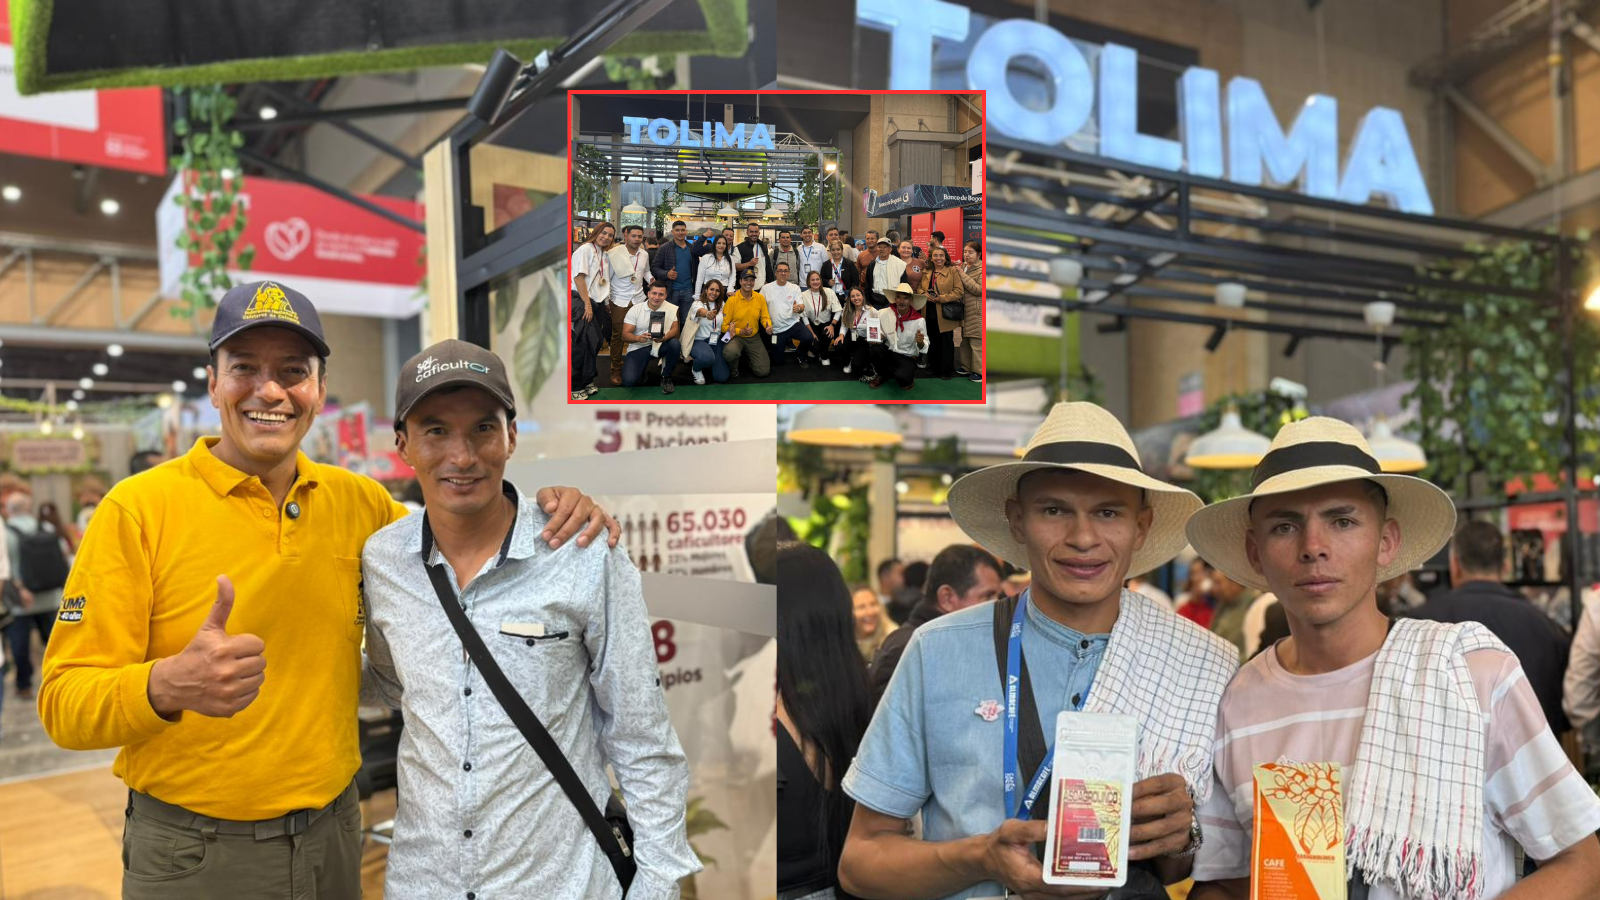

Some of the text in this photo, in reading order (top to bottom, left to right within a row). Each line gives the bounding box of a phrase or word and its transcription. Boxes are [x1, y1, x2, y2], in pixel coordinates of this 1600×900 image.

[856, 0, 1434, 216] TOLIMA
[623, 116, 775, 149] TOLIMA
[415, 360, 490, 383] caficultor
[647, 412, 727, 427] Productor
[667, 508, 746, 534] 65.030
[667, 534, 744, 551] caficultore
[1263, 858, 1285, 867] CAFÉ
